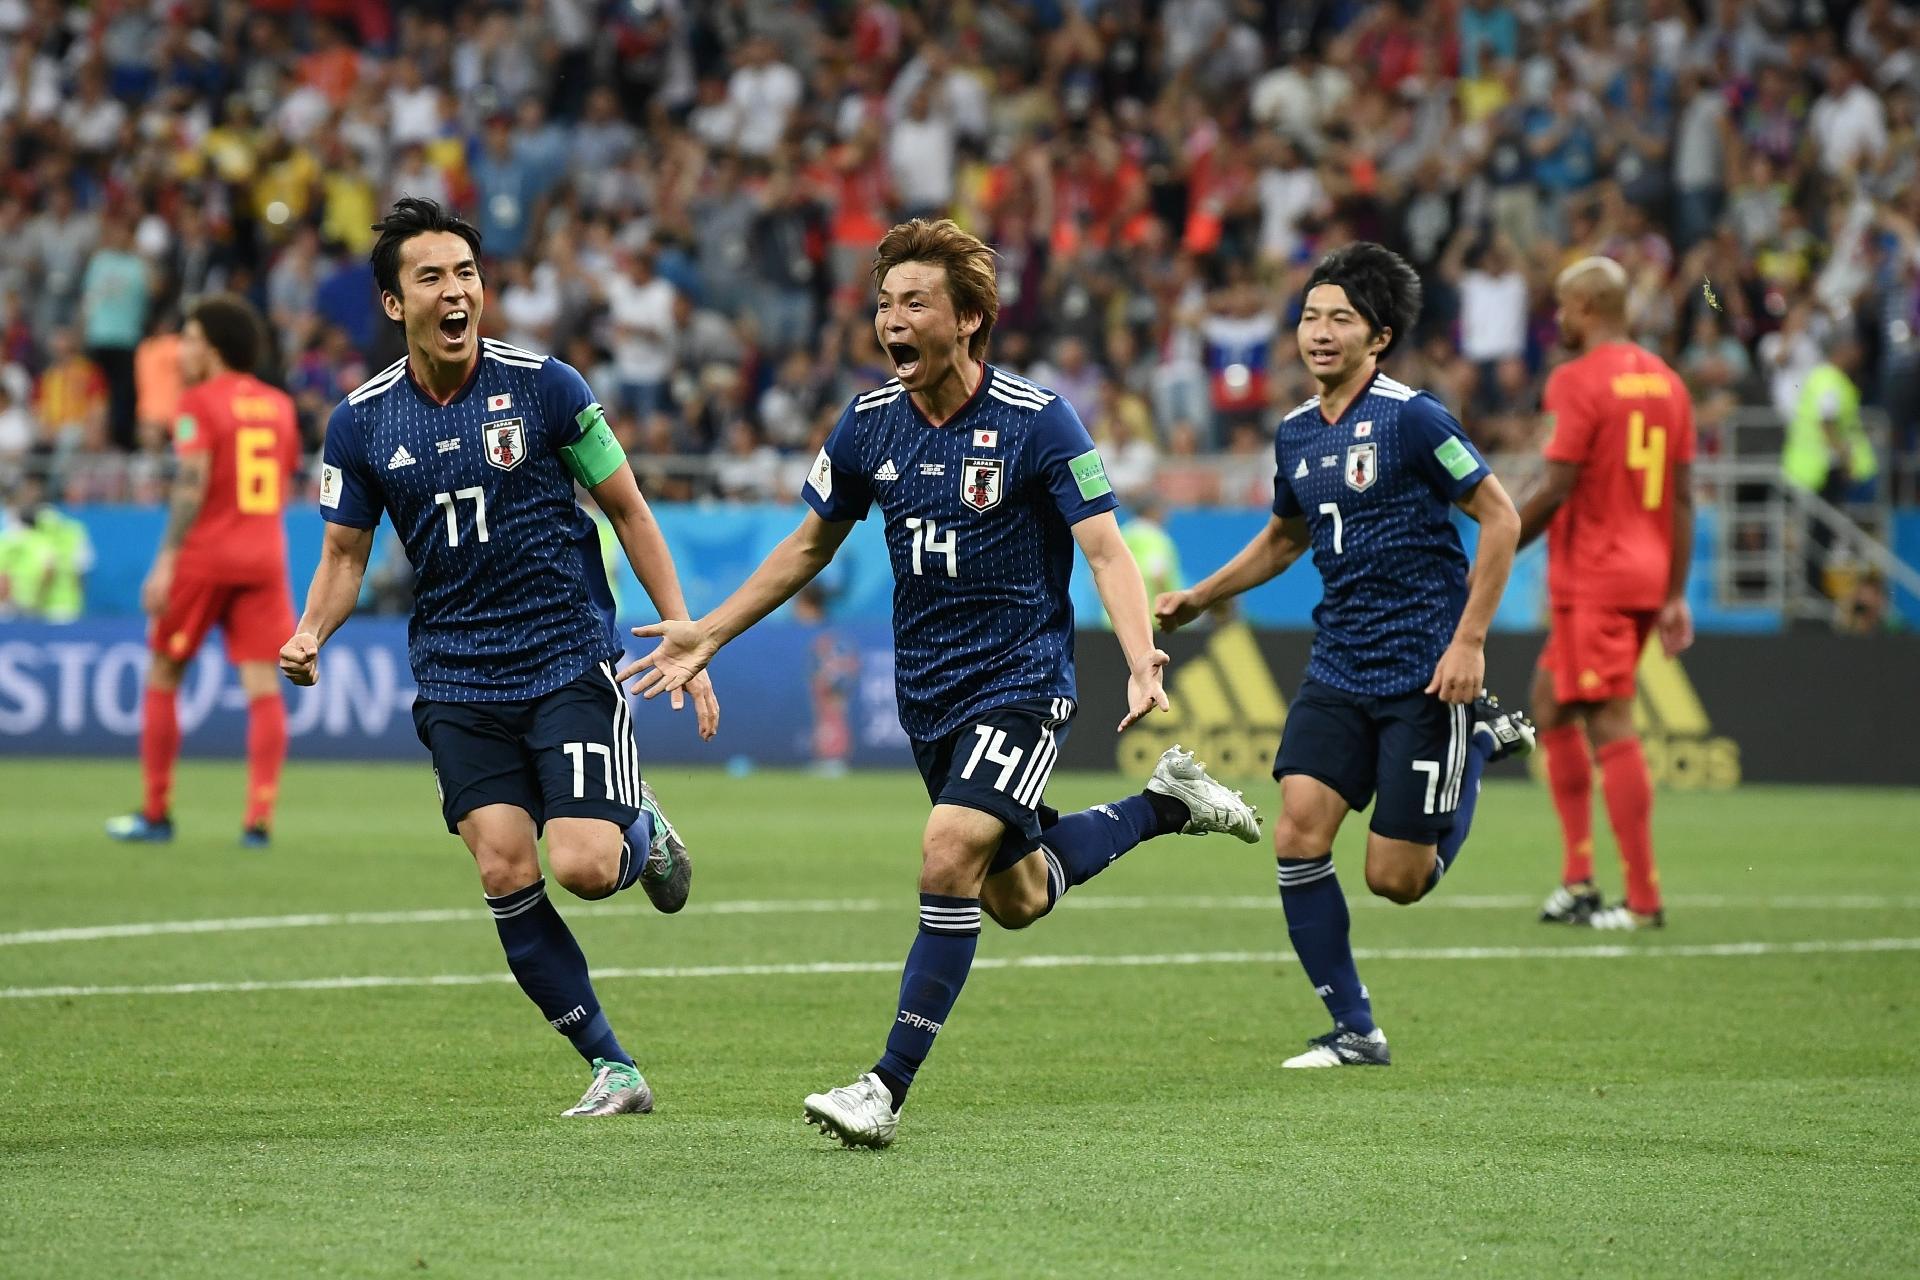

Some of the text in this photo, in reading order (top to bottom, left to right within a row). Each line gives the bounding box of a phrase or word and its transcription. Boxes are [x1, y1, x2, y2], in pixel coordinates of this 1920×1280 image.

[492, 420, 513, 429] JAPAN
[236, 427, 280, 514] 6
[388, 456, 417, 470] adidas
[1627, 410, 1666, 511] 4
[434, 486, 489, 547] 17
[1318, 502, 1343, 555] 7
[905, 517, 958, 578] 14
[563, 742, 615, 801] 17
[960, 723, 1024, 793] 14
[1412, 759, 1440, 815] 7
